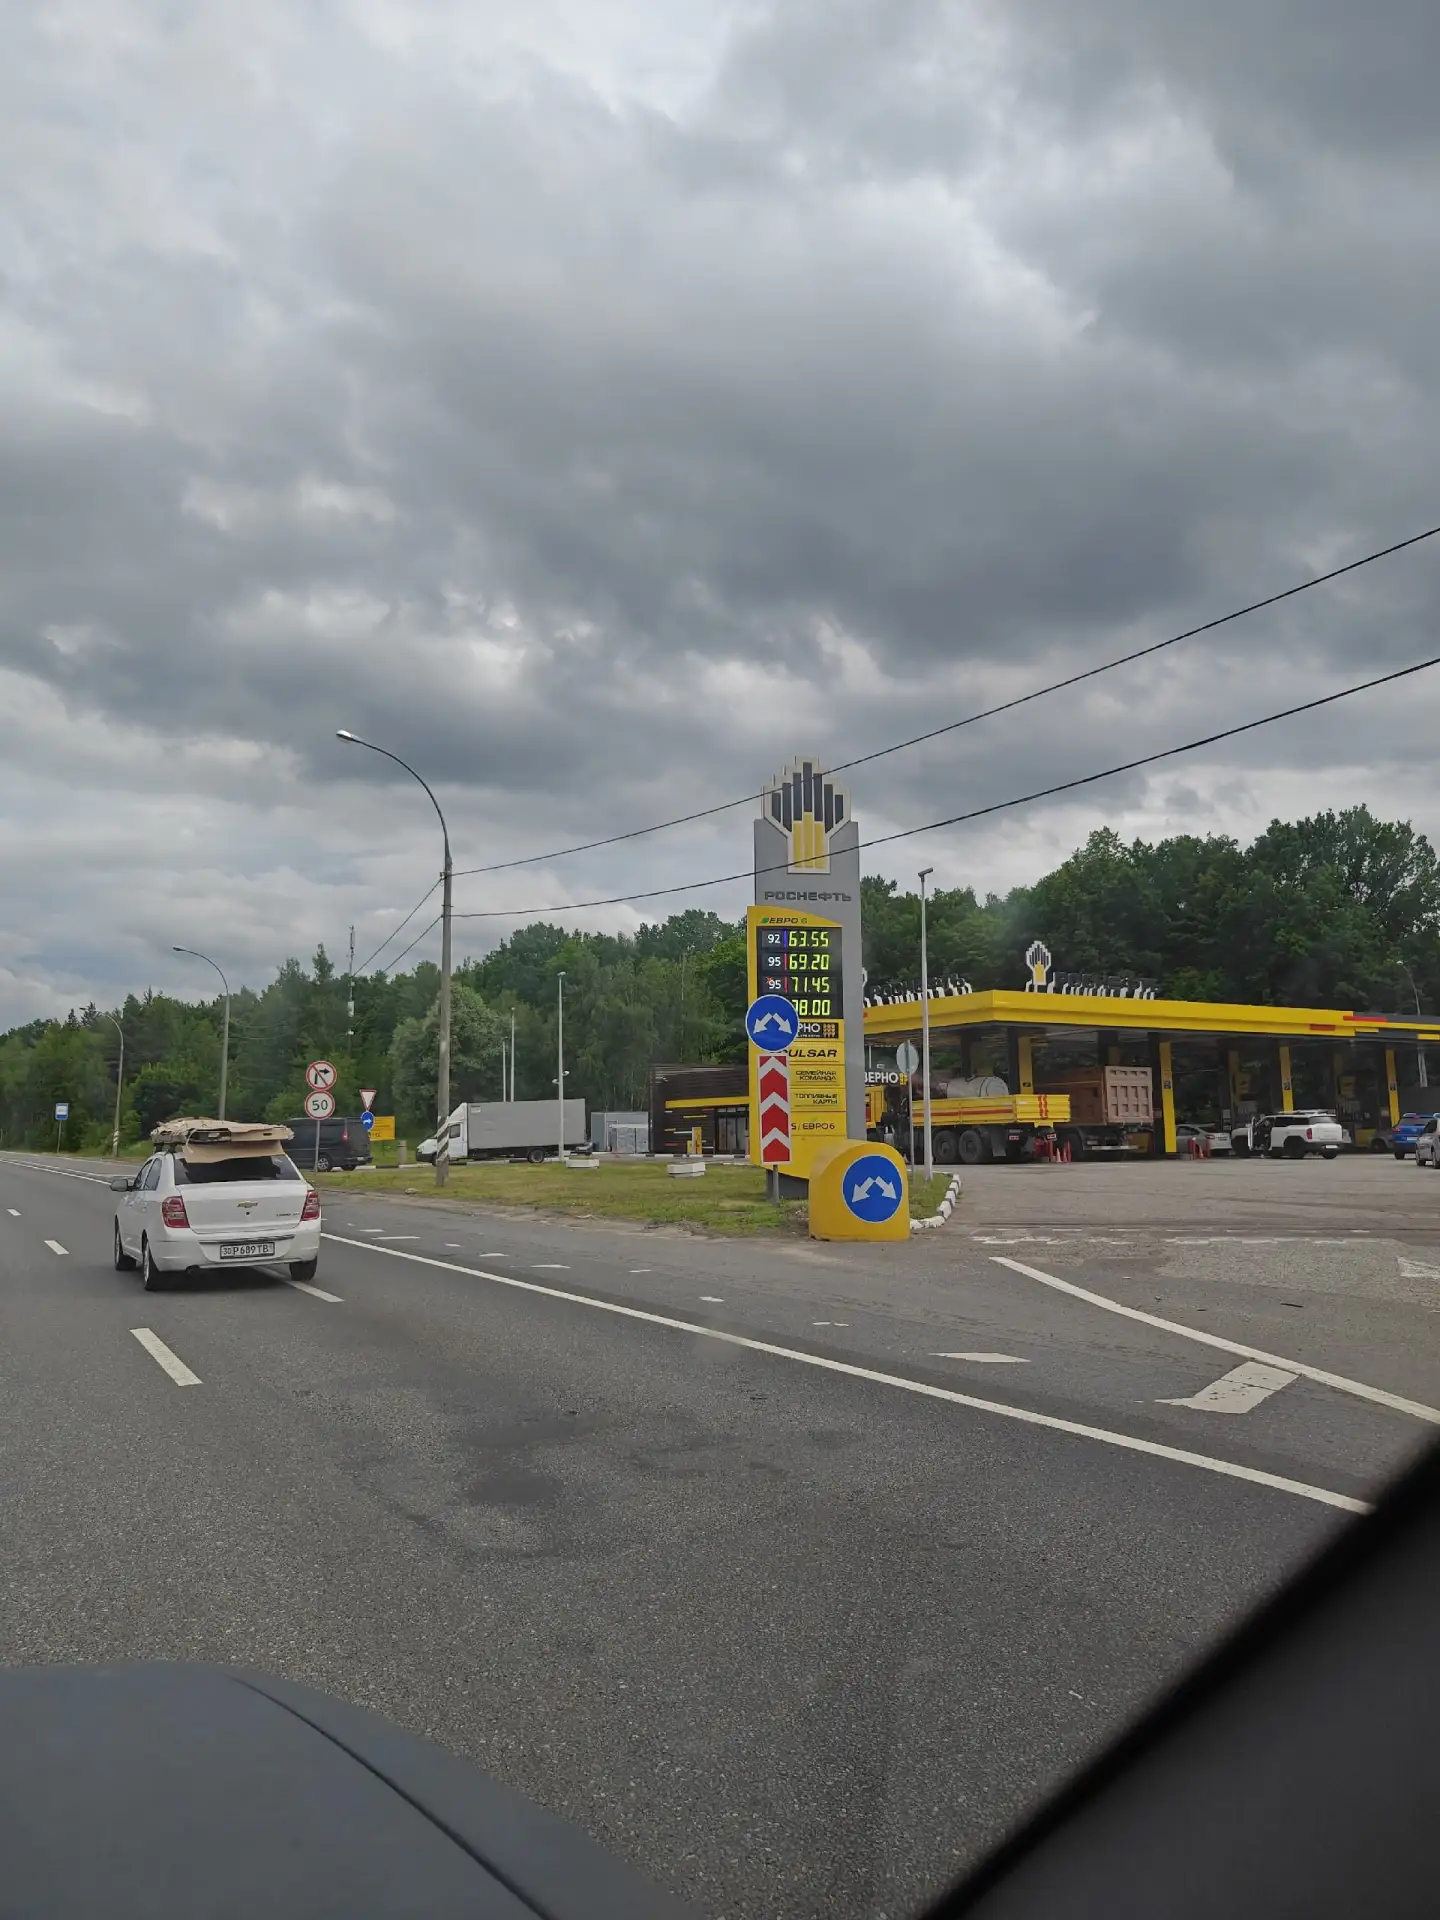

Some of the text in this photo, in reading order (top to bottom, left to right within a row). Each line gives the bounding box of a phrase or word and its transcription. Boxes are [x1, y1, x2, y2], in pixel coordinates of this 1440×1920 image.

[764, 890, 852, 902] РОСНЕФТЬ
[769, 917, 799, 925] ЕВРО
[767, 930, 829, 948] 92 63.55
[768, 954, 830, 970] 95 69.20
[768, 976, 830, 993] 95 71.45
[791, 999, 831, 1016] 78.00
[798, 1023, 821, 1033] РНО
[312, 1099, 328, 1111] 50
